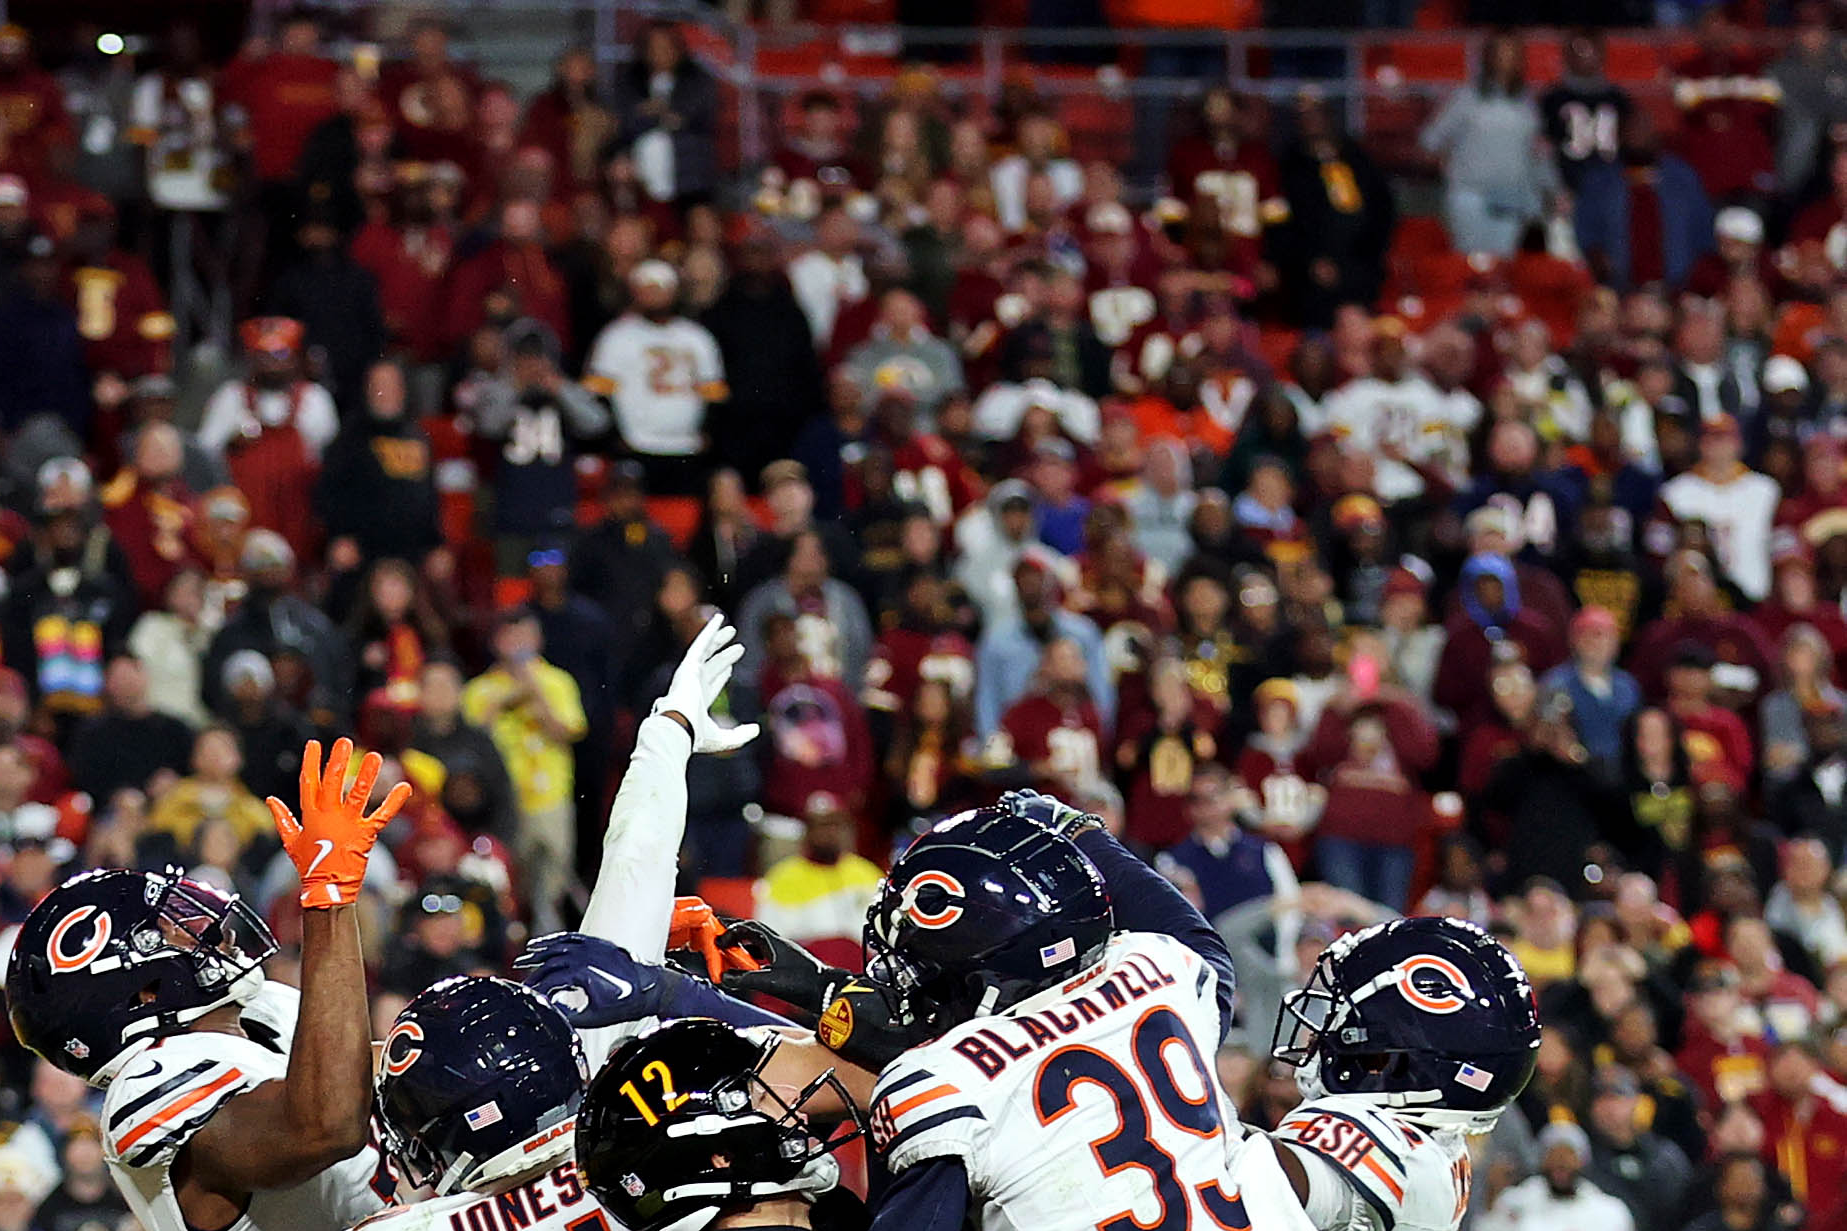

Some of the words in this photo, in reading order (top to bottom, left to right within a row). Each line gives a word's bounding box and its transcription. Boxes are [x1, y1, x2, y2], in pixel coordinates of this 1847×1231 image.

[618, 1059, 691, 1128] 12
[523, 1121, 577, 1154] BEAR
[1297, 1112, 1378, 1172] GSH
